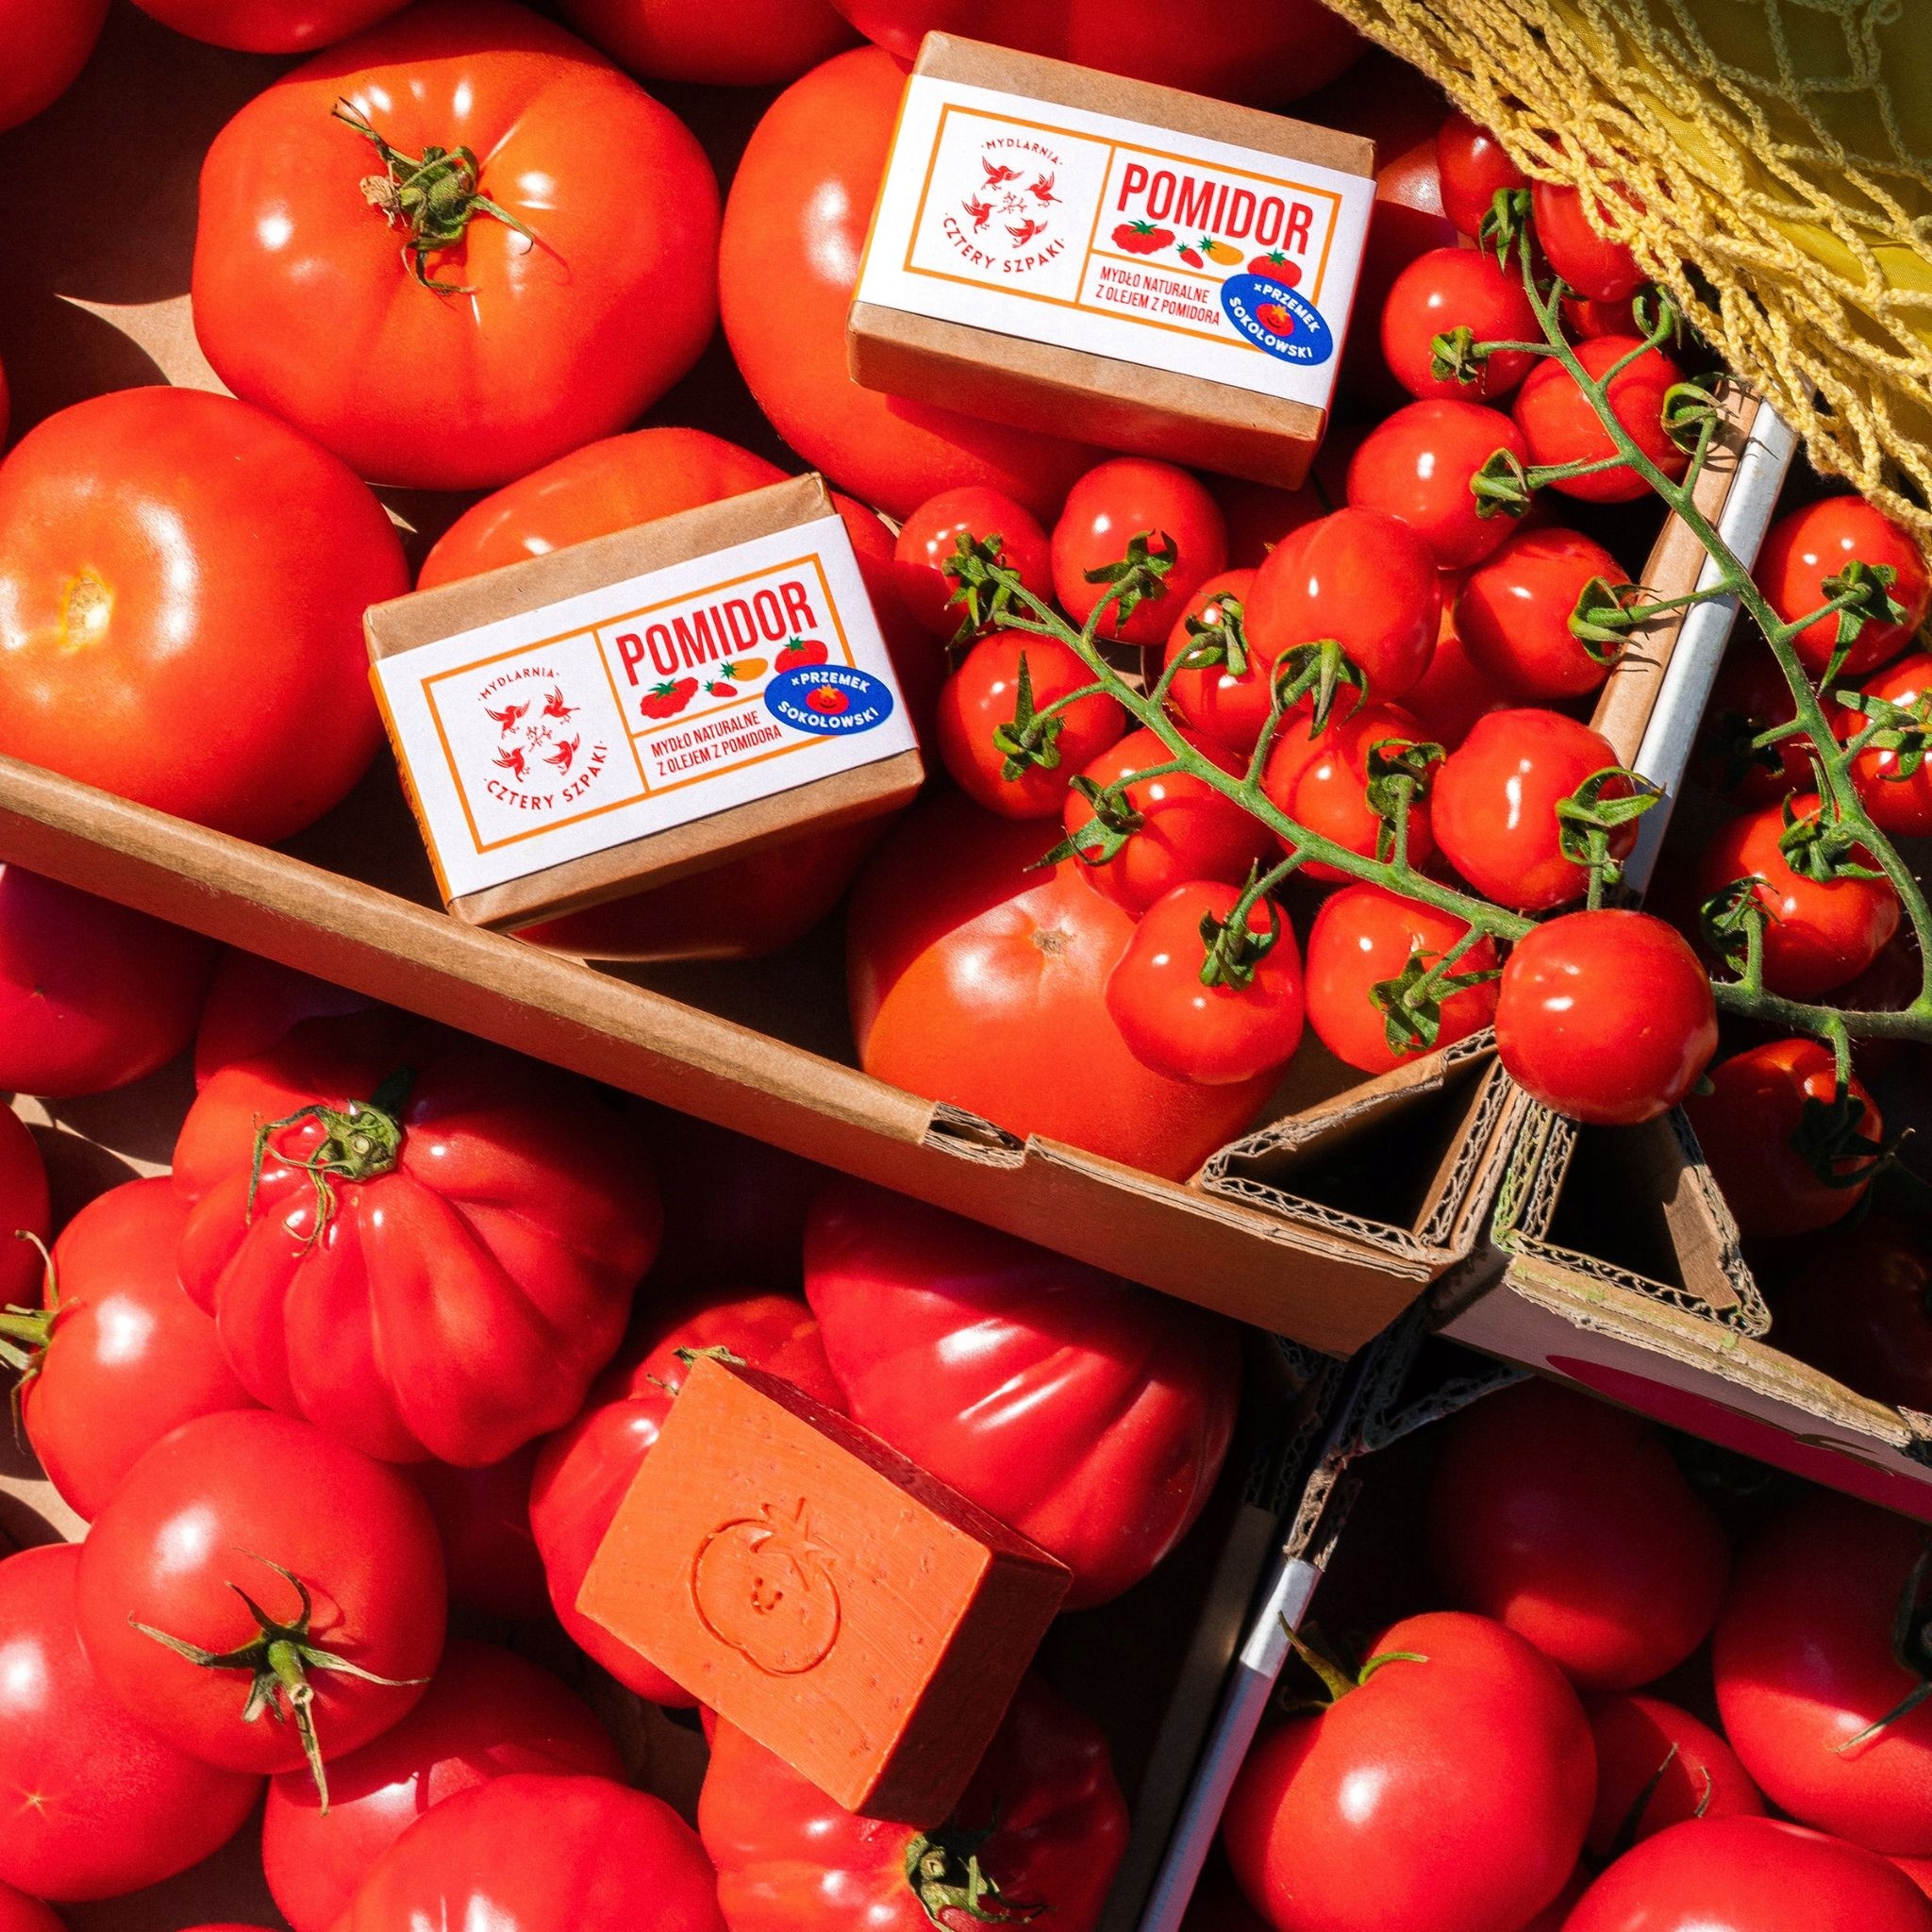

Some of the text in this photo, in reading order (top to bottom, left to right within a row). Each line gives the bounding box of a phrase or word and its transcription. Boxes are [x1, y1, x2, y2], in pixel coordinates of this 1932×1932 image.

[986, 139, 1058, 164] MYDLARNIA
[1117, 163, 1313, 255] POMIDOR
[943, 217, 1065, 273] CZTERY SZPAKI
[1095, 285, 1220, 325] Z OLEJEM Z POMIDORA
[1100, 266, 1210, 304] MYDŁO NATURALNE
[1229, 296, 1313, 359] SOKOŁOWSKI
[615, 581, 818, 687] POMIDOR
[480, 667, 555, 699] MYDLARNIA
[651, 710, 760, 758] MYDŁO NATURALNE
[777, 701, 879, 728] SOKOŁOWSKI
[658, 724, 782, 776] Z OLEJEM Z POMIDORA
[487, 745, 608, 810] CZTERY SZPAKI
